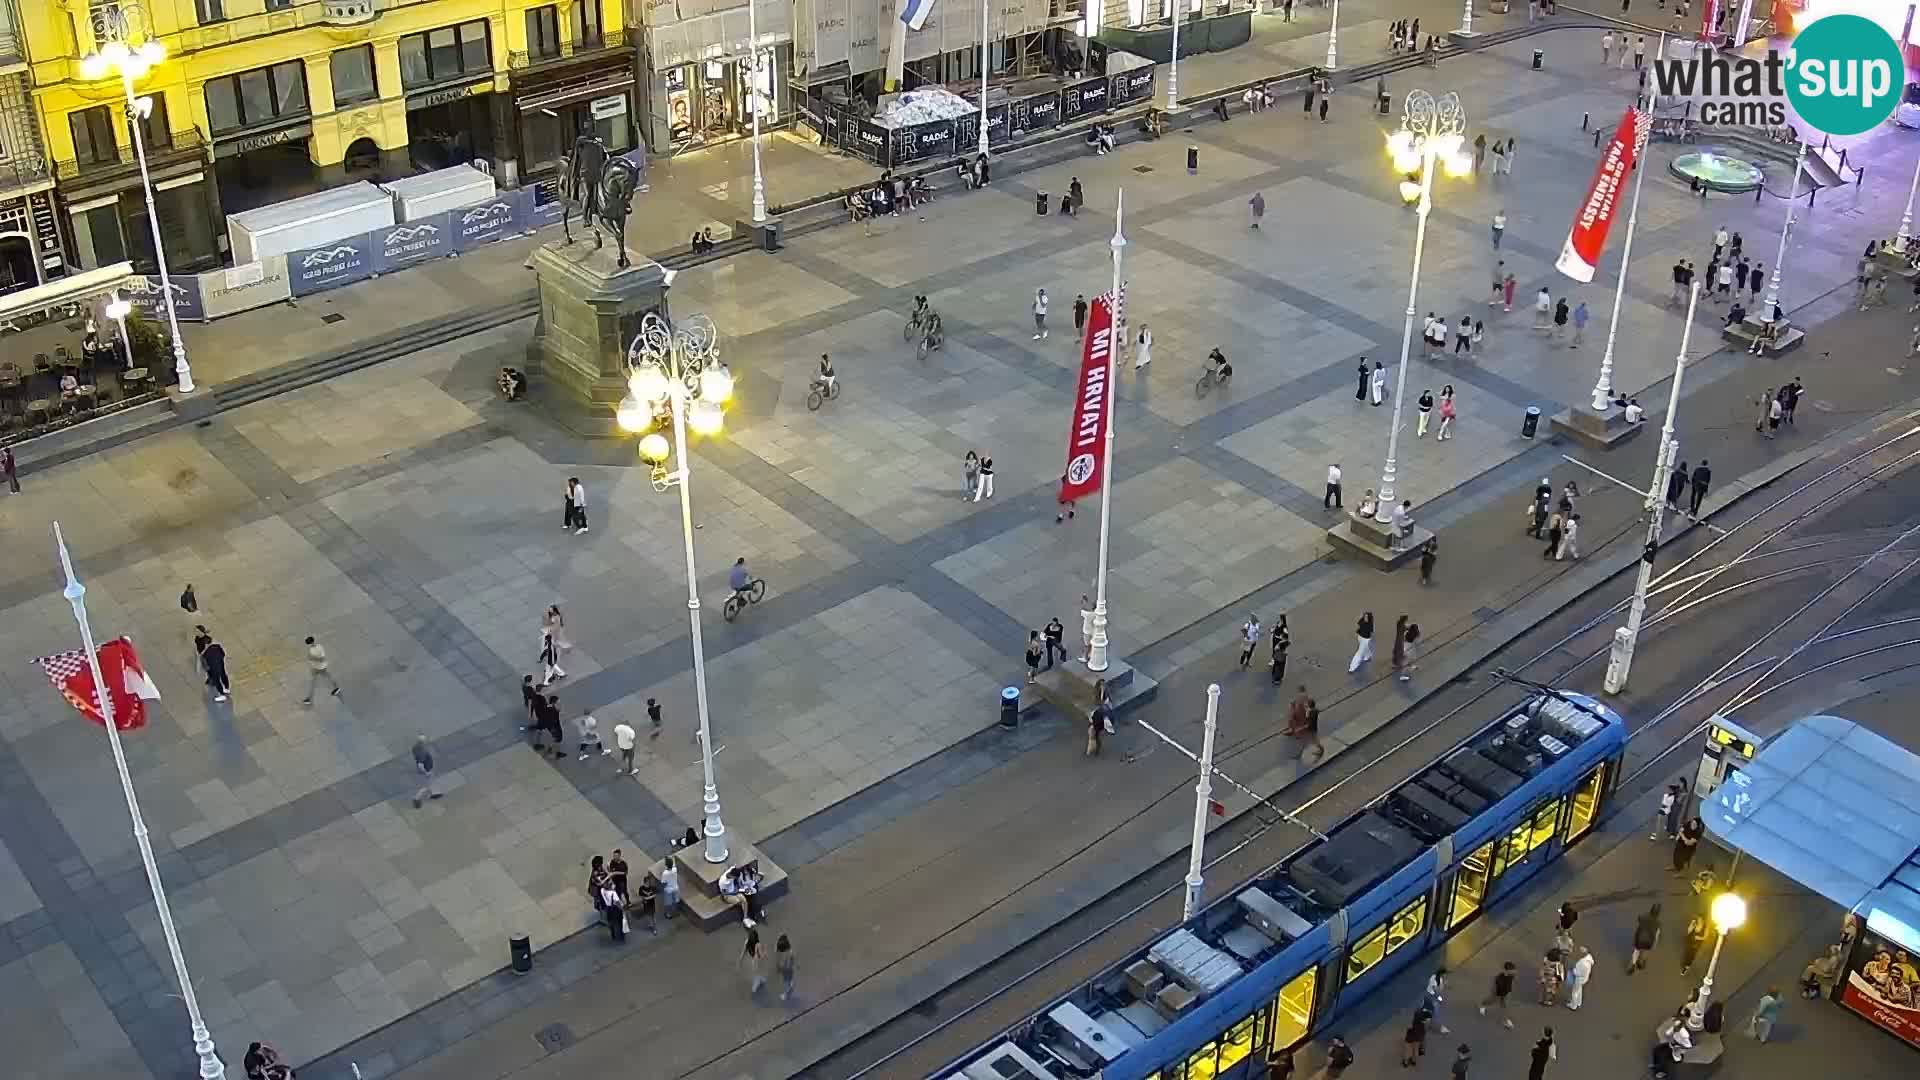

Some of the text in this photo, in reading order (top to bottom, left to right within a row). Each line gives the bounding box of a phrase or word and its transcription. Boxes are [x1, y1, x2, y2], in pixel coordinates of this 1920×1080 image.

[1579, 140, 1625, 232] FANS EMBASSY
[1598, 160, 1625, 221] CROATIAN
[1077, 327, 1111, 447] MI HRVATI
